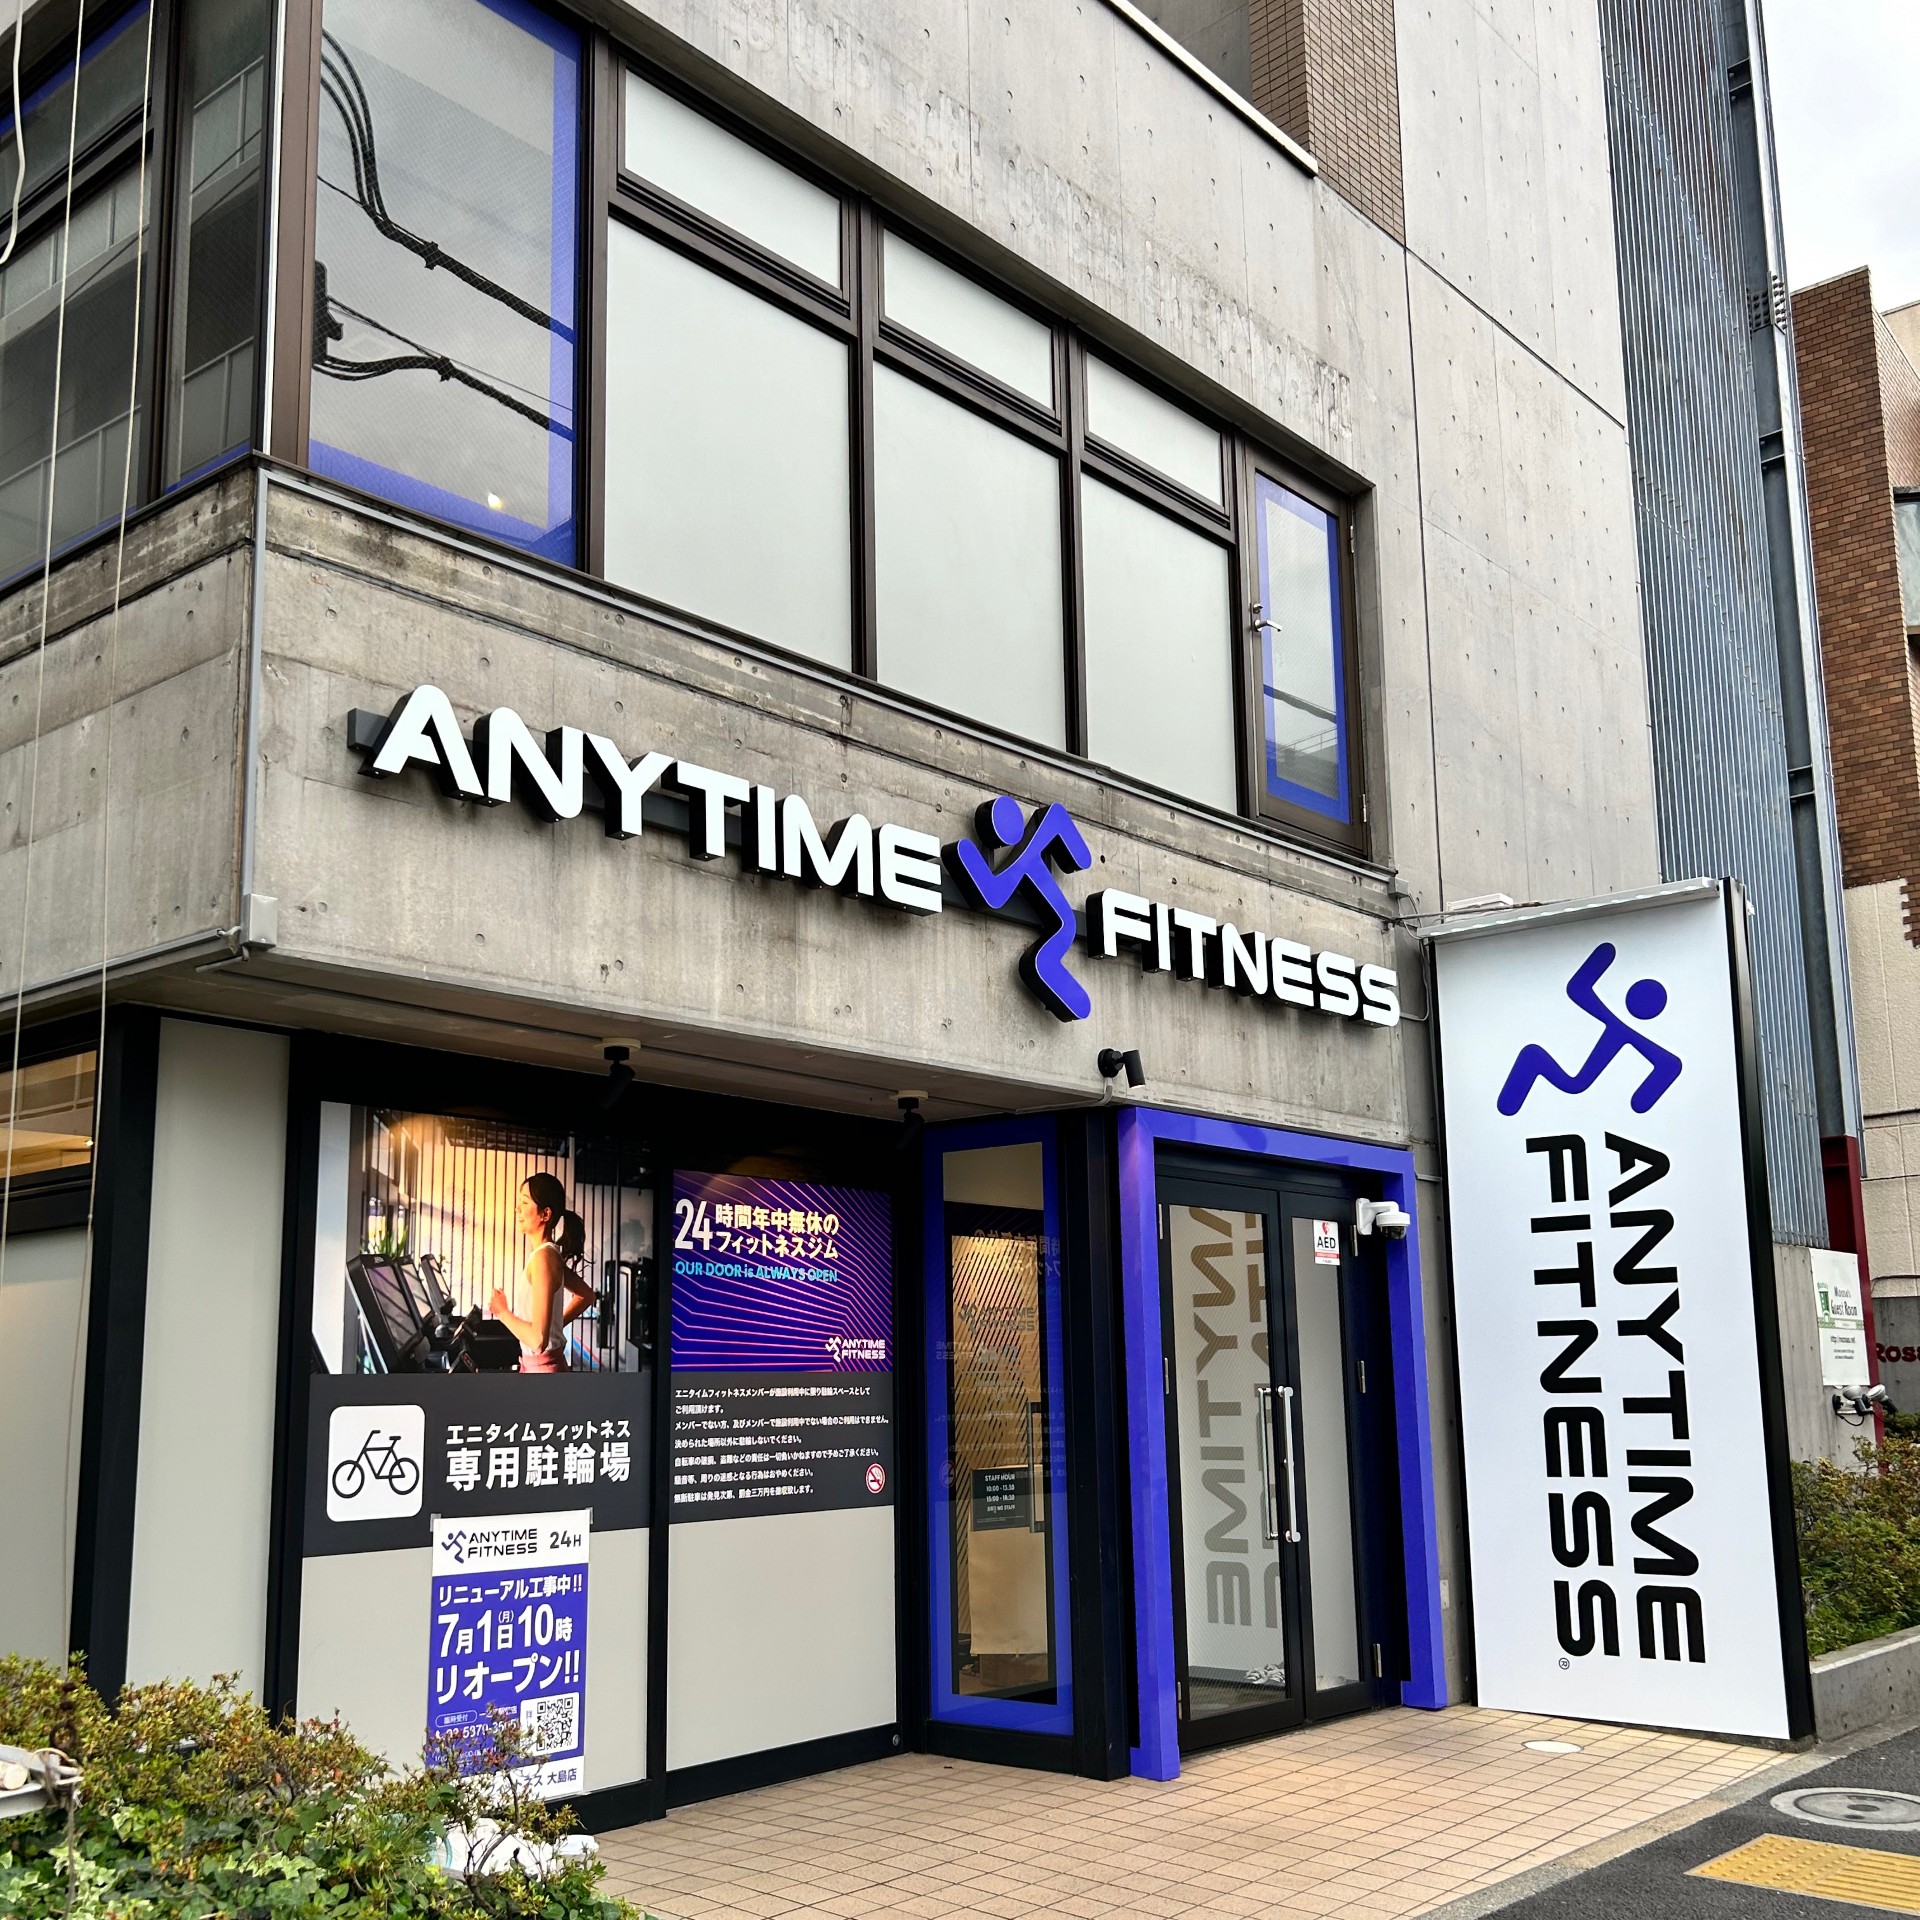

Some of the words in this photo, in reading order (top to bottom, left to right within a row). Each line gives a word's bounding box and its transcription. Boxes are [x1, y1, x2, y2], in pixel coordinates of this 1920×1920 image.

[372, 684, 942, 914] ANYTIME
[1101, 887, 1401, 1028] FITNESS
[674, 1198, 713, 1251] 24
[715, 1203, 840, 1236] 時間年中無休の
[715, 1231, 839, 1259] フィットネスジム
[1317, 1235, 1336, 1249] AED
[675, 1261, 703, 1275] OUR
[705, 1263, 742, 1278] DOOR
[744, 1264, 754, 1278] is
[756, 1264, 806, 1281] ALWAYS
[807, 1268, 838, 1282] OPEN
[841, 1338, 886, 1349] ANYTIME
[841, 1350, 886, 1359] FITNESS
[1525, 1133, 1620, 1658] FITNESS
[1604, 1131, 1706, 1664] ANYTIME
[446, 1419, 631, 1445] エニタイムフィットネス
[446, 1441, 631, 1492] 専用駐輪場
[467, 1542, 538, 1558] FITNESS
[468, 1528, 538, 1544] ANYTIME
[549, 1531, 582, 1549] 24H
[436, 1649, 580, 1705] リオープン!!
[546, 1767, 577, 1785] 大島店
